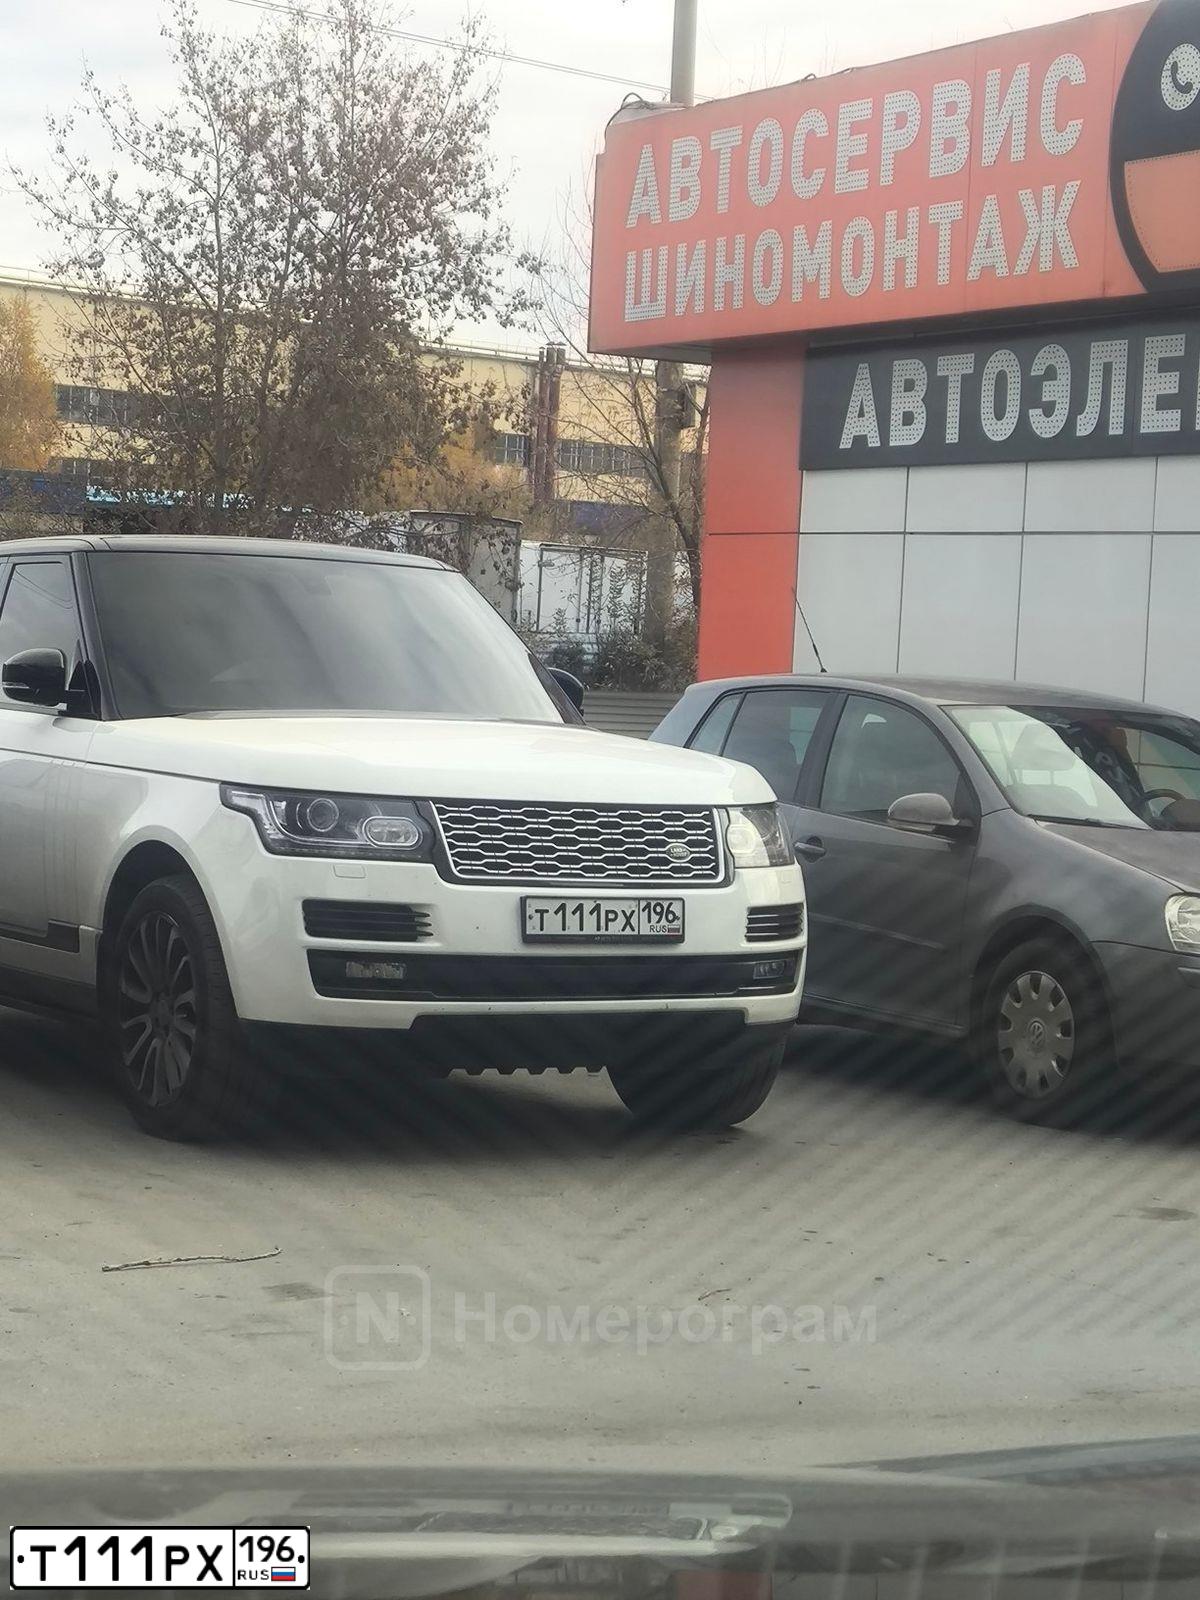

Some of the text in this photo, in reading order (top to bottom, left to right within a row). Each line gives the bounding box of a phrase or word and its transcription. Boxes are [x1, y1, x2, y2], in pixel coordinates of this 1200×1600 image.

[624, 52, 1087, 229] АВТОСЕРВИС
[623, 179, 1081, 322] ШИНОМОНТАЖ
[838, 332, 1200, 450] АВТОЭЛЕ
[534, 901, 677, 932] Т111РХ 196
[649, 924, 667, 933] RUS
